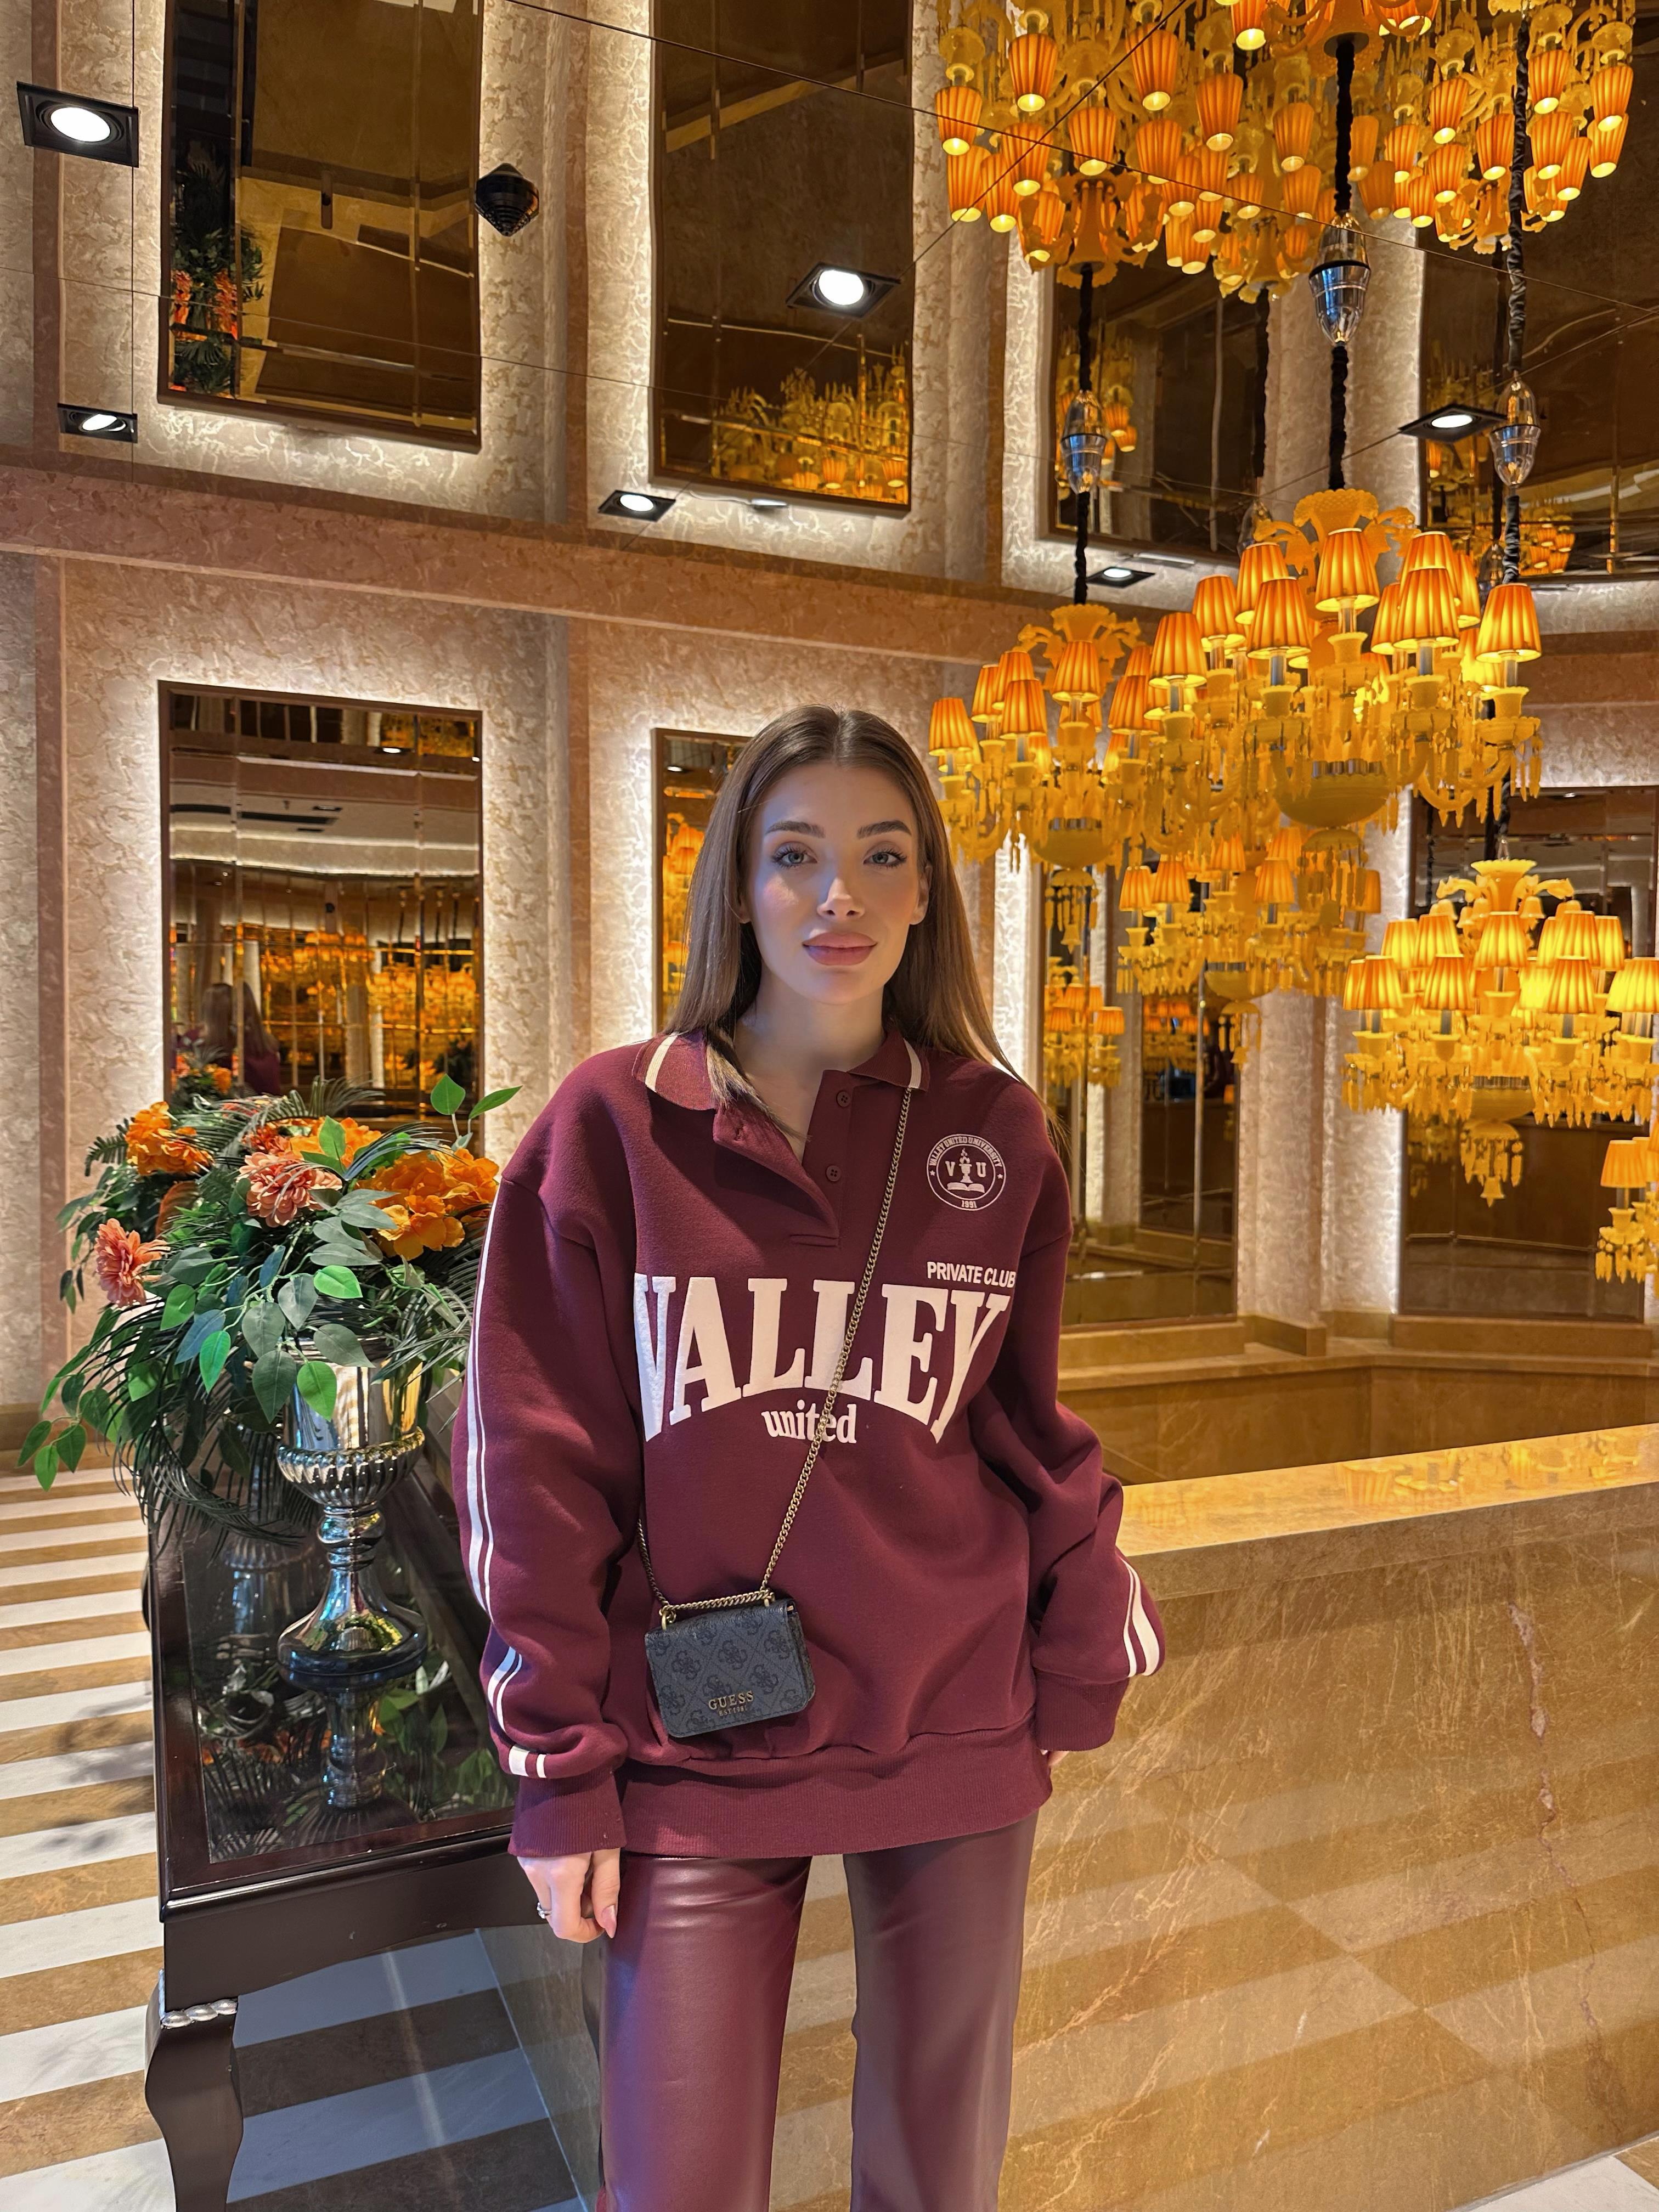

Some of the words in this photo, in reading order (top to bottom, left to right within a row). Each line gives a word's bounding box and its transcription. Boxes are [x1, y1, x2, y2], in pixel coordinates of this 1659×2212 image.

[929, 1143, 946, 1166] VALLEY
[943, 1136, 968, 1148] UNITED
[968, 1137, 1003, 1167] UNIVERSITY
[945, 1161, 956, 1177] V
[975, 1161, 987, 1178] U
[961, 1200, 978, 1209] 1991
[927, 1261, 984, 1284] PRIVATE
[984, 1267, 1017, 1288] CLUB
[634, 1272, 1011, 1444] VALLEY
[760, 1399, 857, 1444] united
[708, 1690, 754, 1710] GUESS
